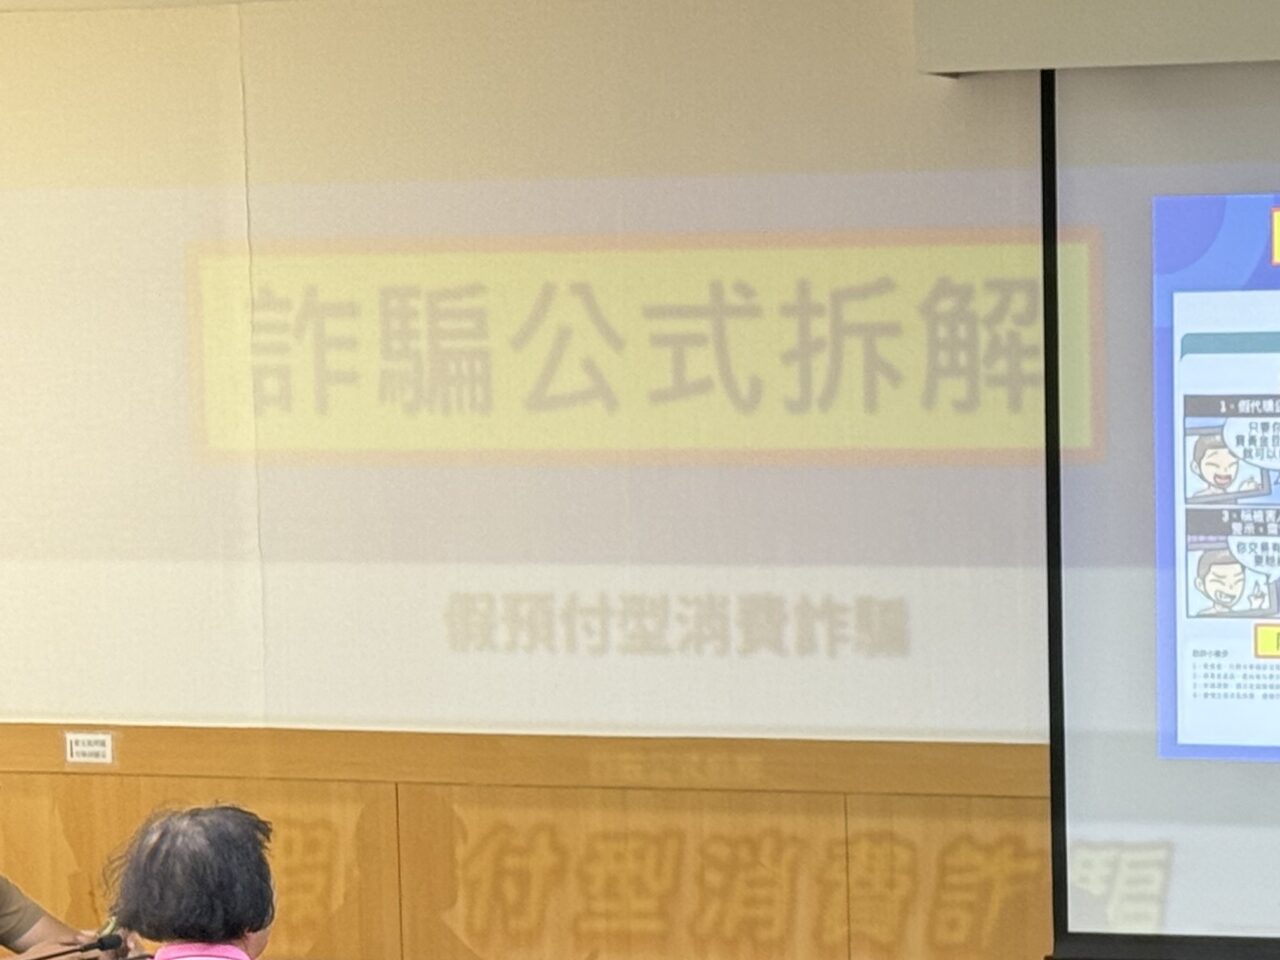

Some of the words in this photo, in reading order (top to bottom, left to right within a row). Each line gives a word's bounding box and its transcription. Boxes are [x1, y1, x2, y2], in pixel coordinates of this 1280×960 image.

[249, 276, 1044, 417] 詐騙公式拆解
